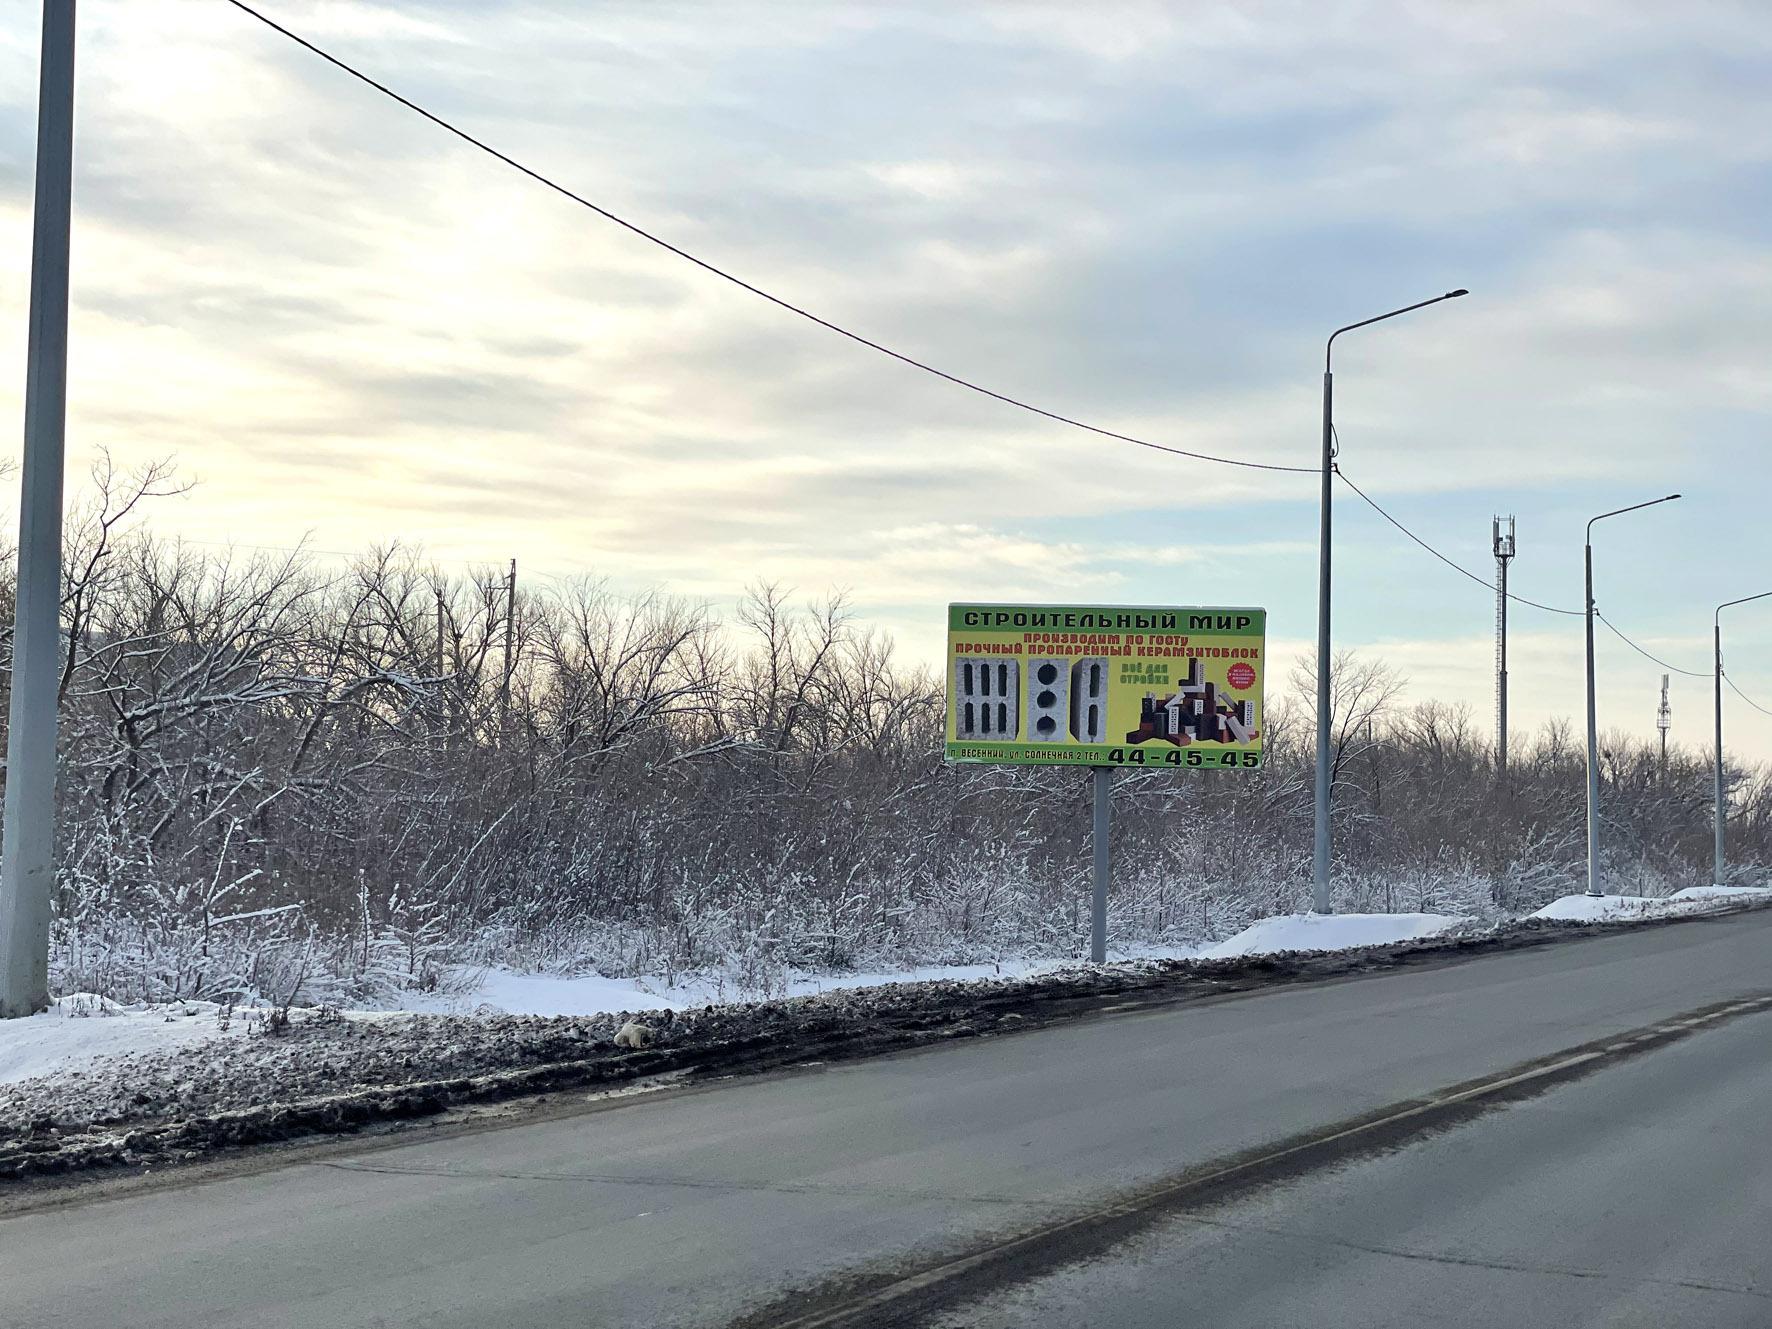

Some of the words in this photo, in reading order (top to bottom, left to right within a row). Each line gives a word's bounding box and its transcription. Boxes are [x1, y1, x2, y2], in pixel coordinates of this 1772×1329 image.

[964, 612, 1177, 629] СТРОИТЕЛЬНЫЙ
[1189, 615, 1251, 630] МИР
[1023, 633, 1120, 646] ПРОИЗВОДИМ
[1125, 635, 1144, 646] ПО
[955, 643, 1023, 654] ПРОЧНЫЙ
[1028, 645, 1132, 657] ПРОПАРЕННЫЙ
[1137, 646, 1259, 659] КЕРАМЗИТОБЛОК
[1024, 750, 1074, 760] СОЛНЕЧНАЯ
[1076, 751, 1082, 760] 2
[1107, 748, 1259, 768] 44-45-45
